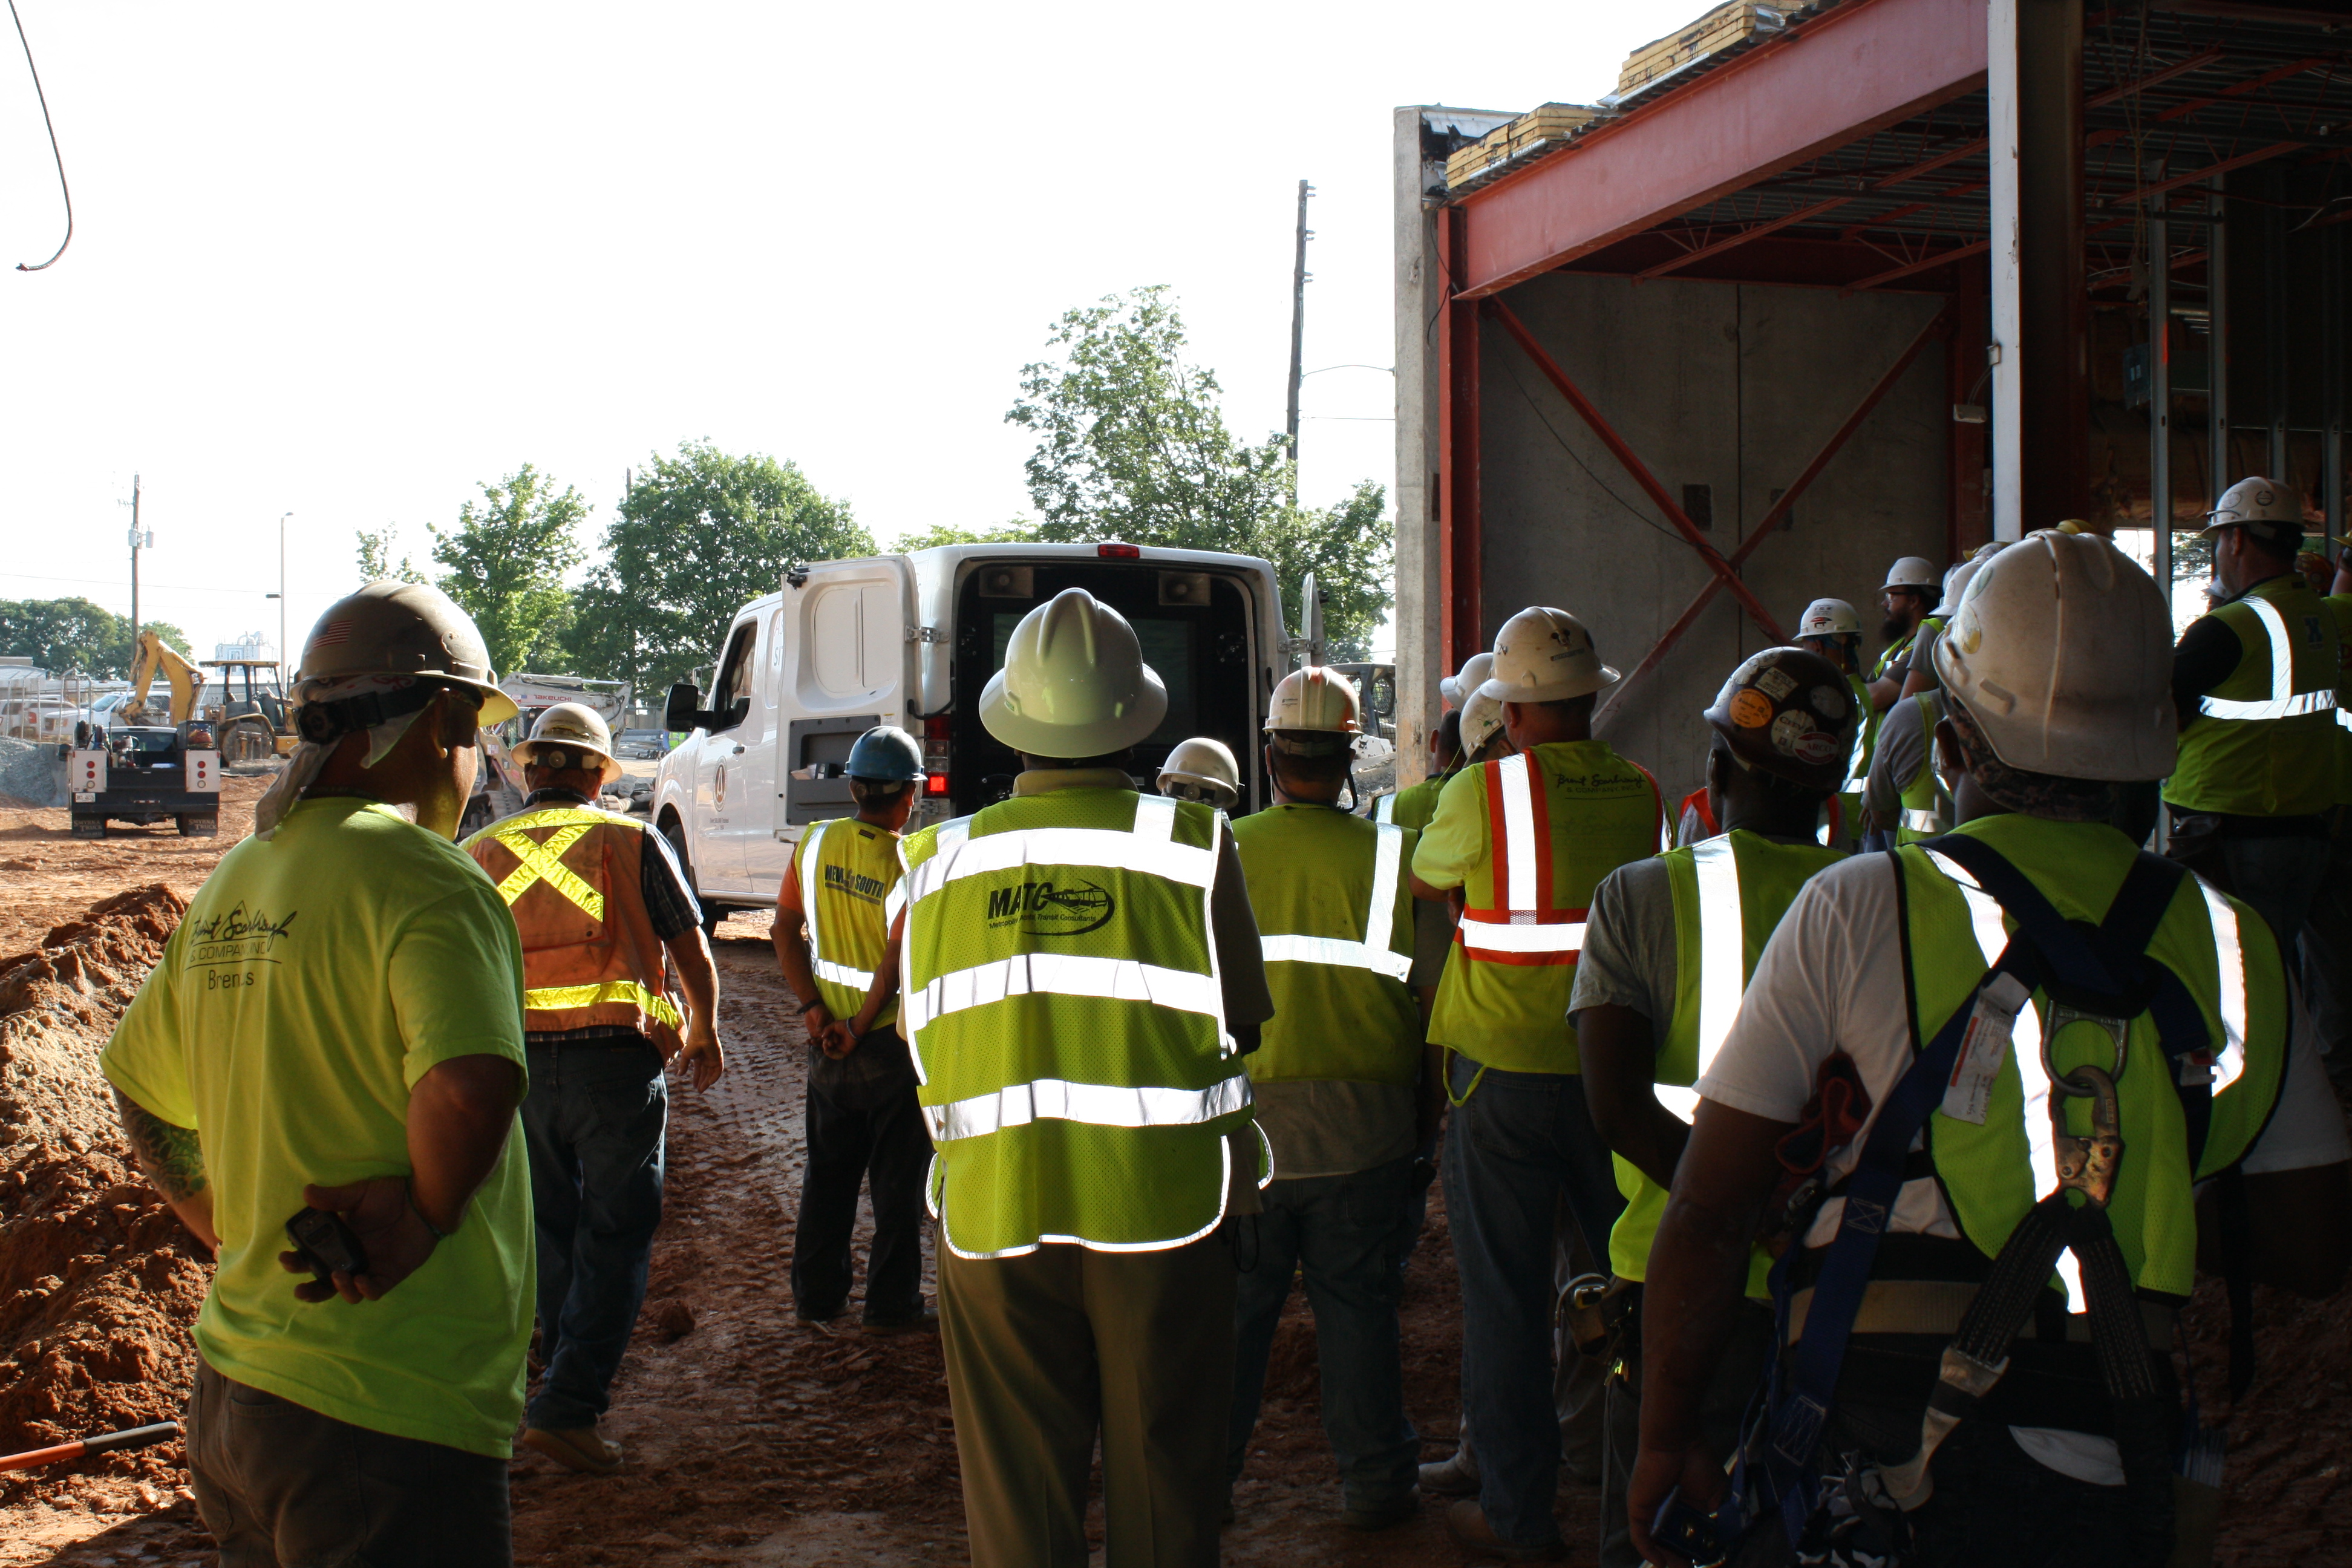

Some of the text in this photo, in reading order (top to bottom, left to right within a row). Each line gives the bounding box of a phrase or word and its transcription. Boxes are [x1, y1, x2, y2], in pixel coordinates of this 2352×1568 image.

[1805, 743, 1832, 753] ARCO
[825, 864, 884, 898] NEW SOUTH
[988, 882, 1053, 920] MATC
